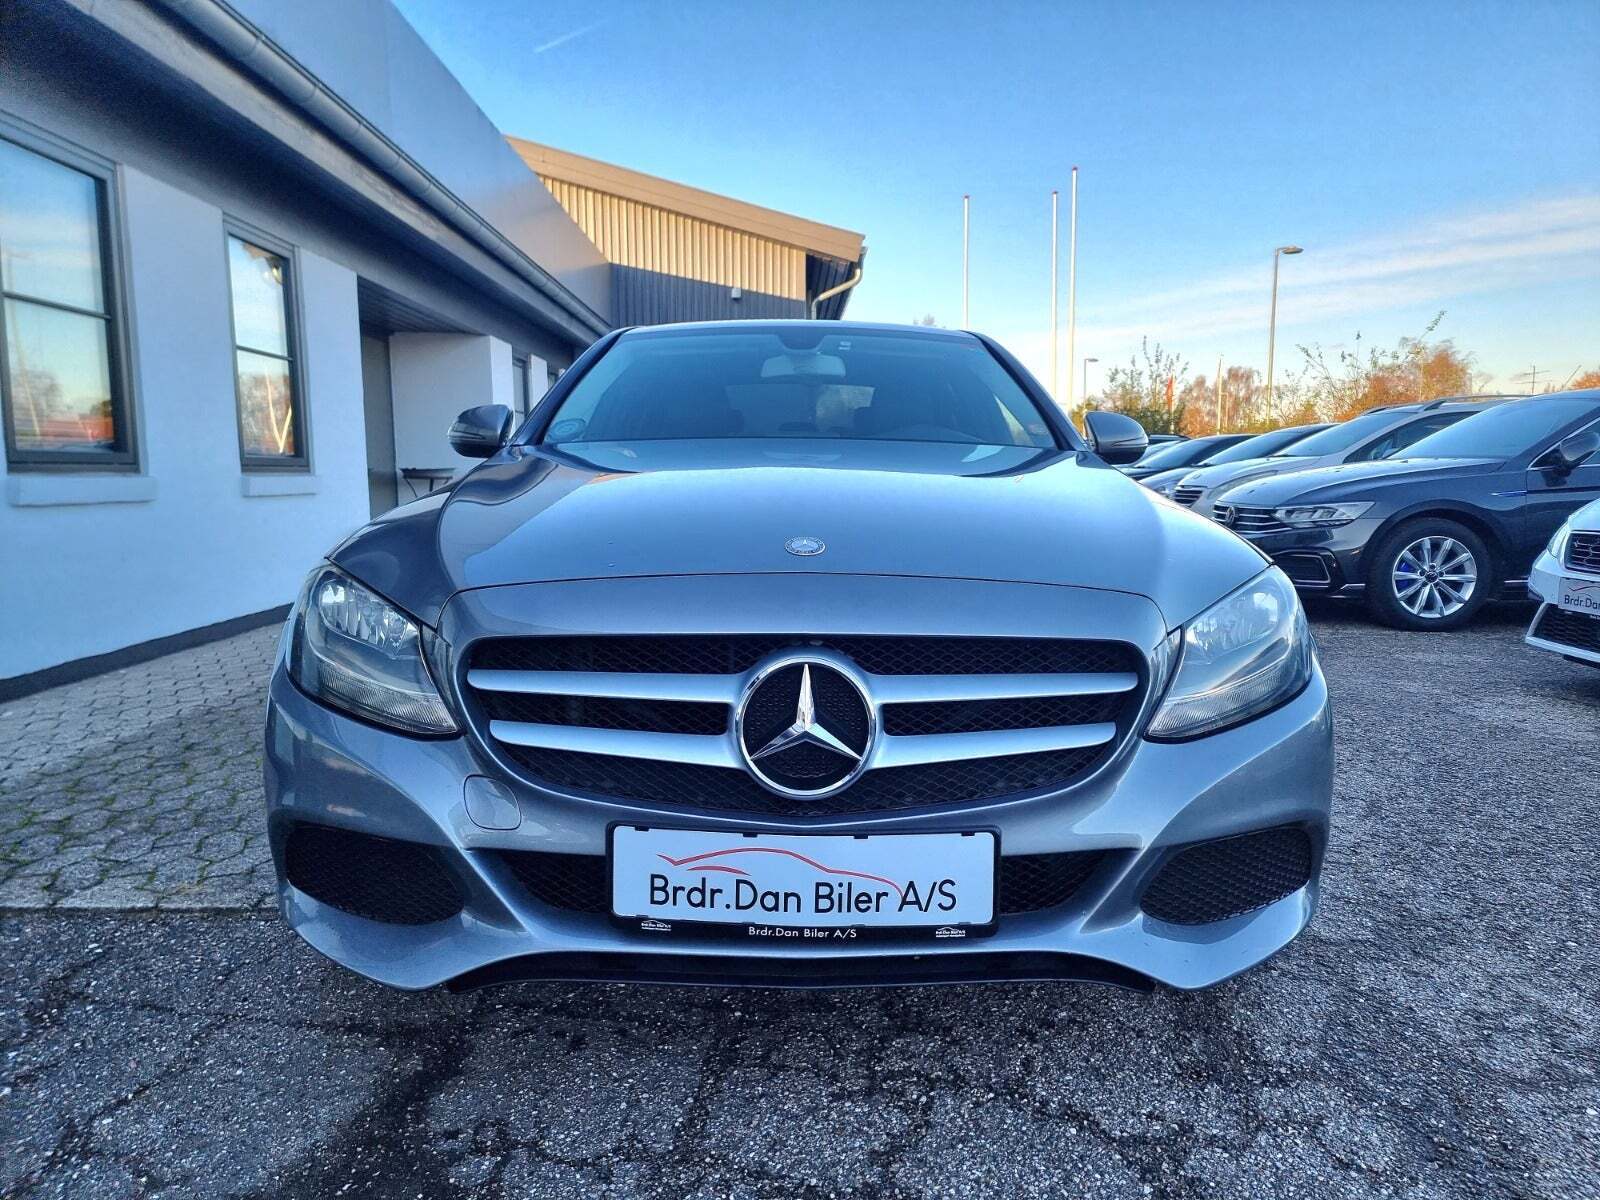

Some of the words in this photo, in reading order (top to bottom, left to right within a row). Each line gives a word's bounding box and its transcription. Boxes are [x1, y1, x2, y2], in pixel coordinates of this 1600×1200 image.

[1564, 594, 1600, 610] Brdr.Da
[650, 873, 802, 913] Brdr.Dan
[814, 881, 889, 914] Biler
[897, 878, 957, 913] A/S
[748, 926, 799, 937] Brdr.Dan
[803, 928, 830, 938] Biler
[833, 928, 857, 939] A/S
